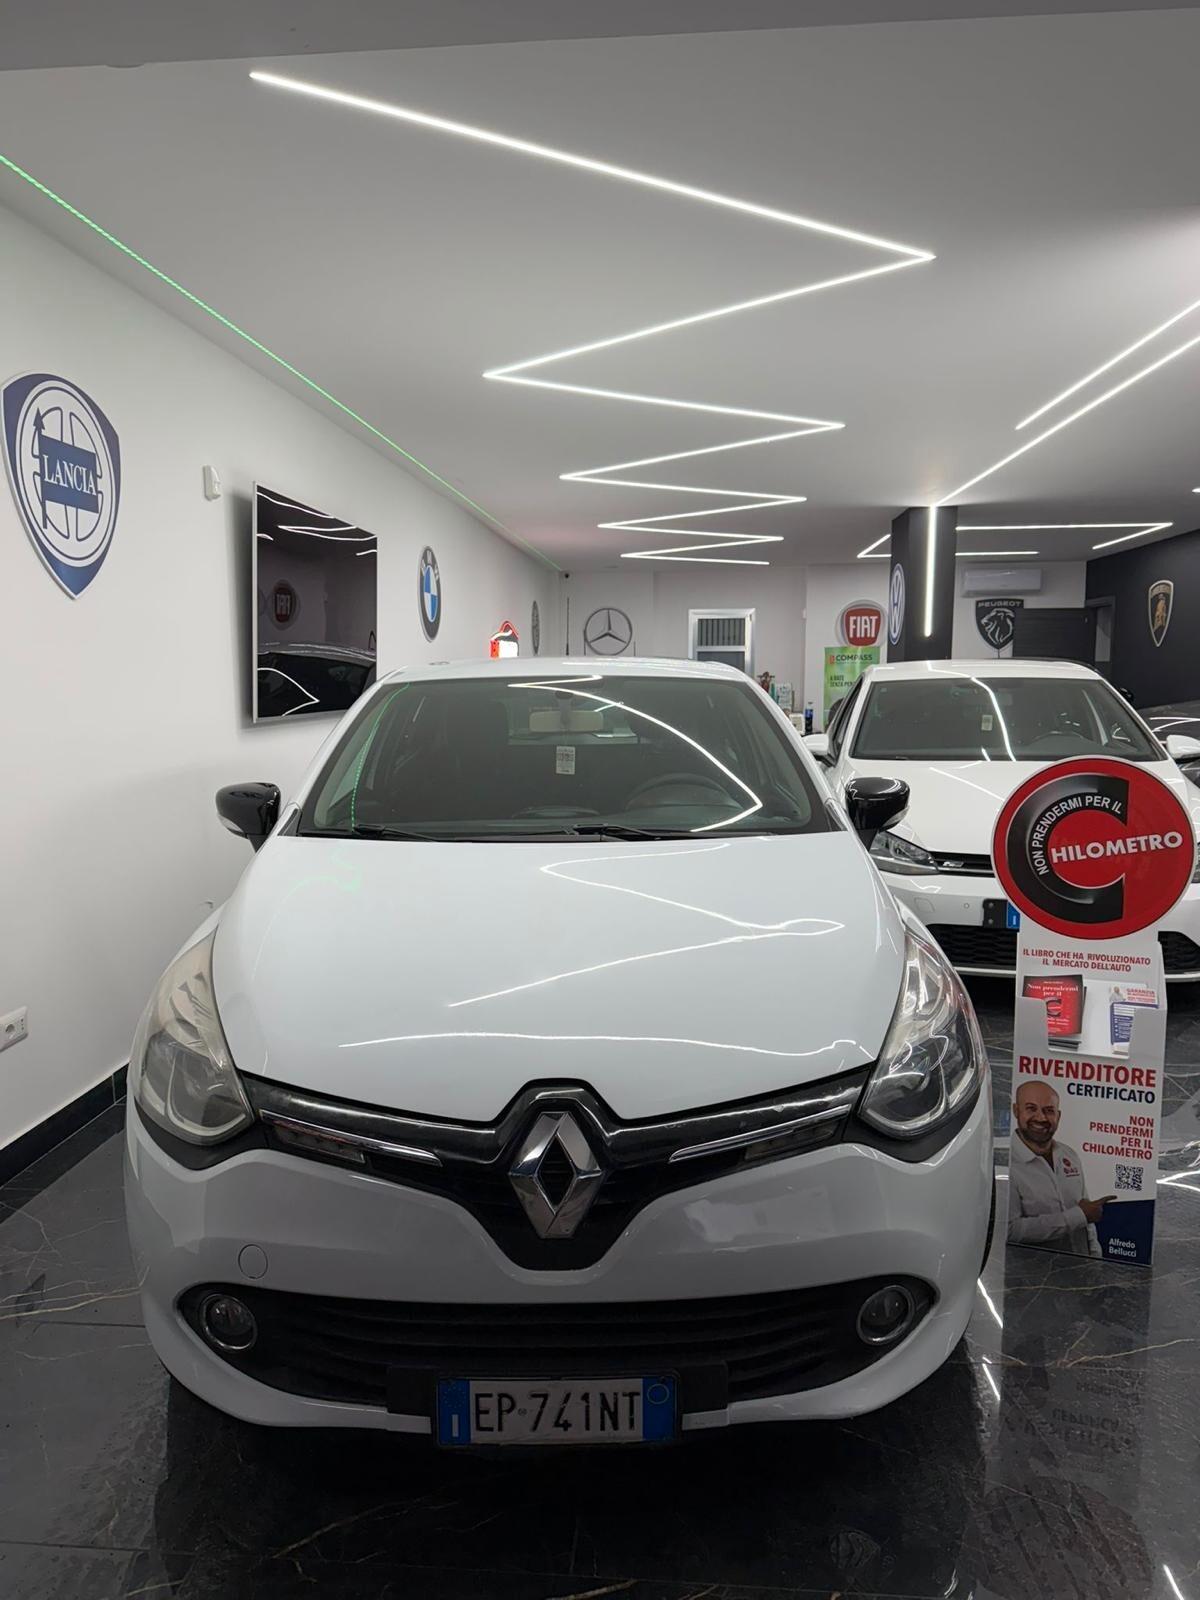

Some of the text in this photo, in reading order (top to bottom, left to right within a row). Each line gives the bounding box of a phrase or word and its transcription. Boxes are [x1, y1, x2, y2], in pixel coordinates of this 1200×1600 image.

[43, 455, 97, 496] LANCIA
[978, 600, 1022, 608] PEUGEOT
[849, 615, 879, 639] FIAT
[835, 654, 873, 662] COMPASS
[1032, 795, 1123, 876] NON PRENDERMI PER IL
[1023, 948, 1151, 966] IL LIBRO CHE HA RIVOLUZIONATO
[1052, 959, 1089, 969] MERCATO
[1091, 962, 1131, 972] DELL'AUTO
[1018, 1055, 1157, 1088] RIVENDITORE
[1066, 1082, 1156, 1104] CERTIFICATO
[1089, 1121, 1154, 1138] PRENDERMI
[1129, 1115, 1154, 1127] NON
[1082, 1142, 1153, 1160] CHILOMETRO
[1120, 1136, 1154, 1149] PER IL
[1108, 1237, 1136, 1249] Alfredo
[1108, 1246, 1137, 1258] Bellucci
